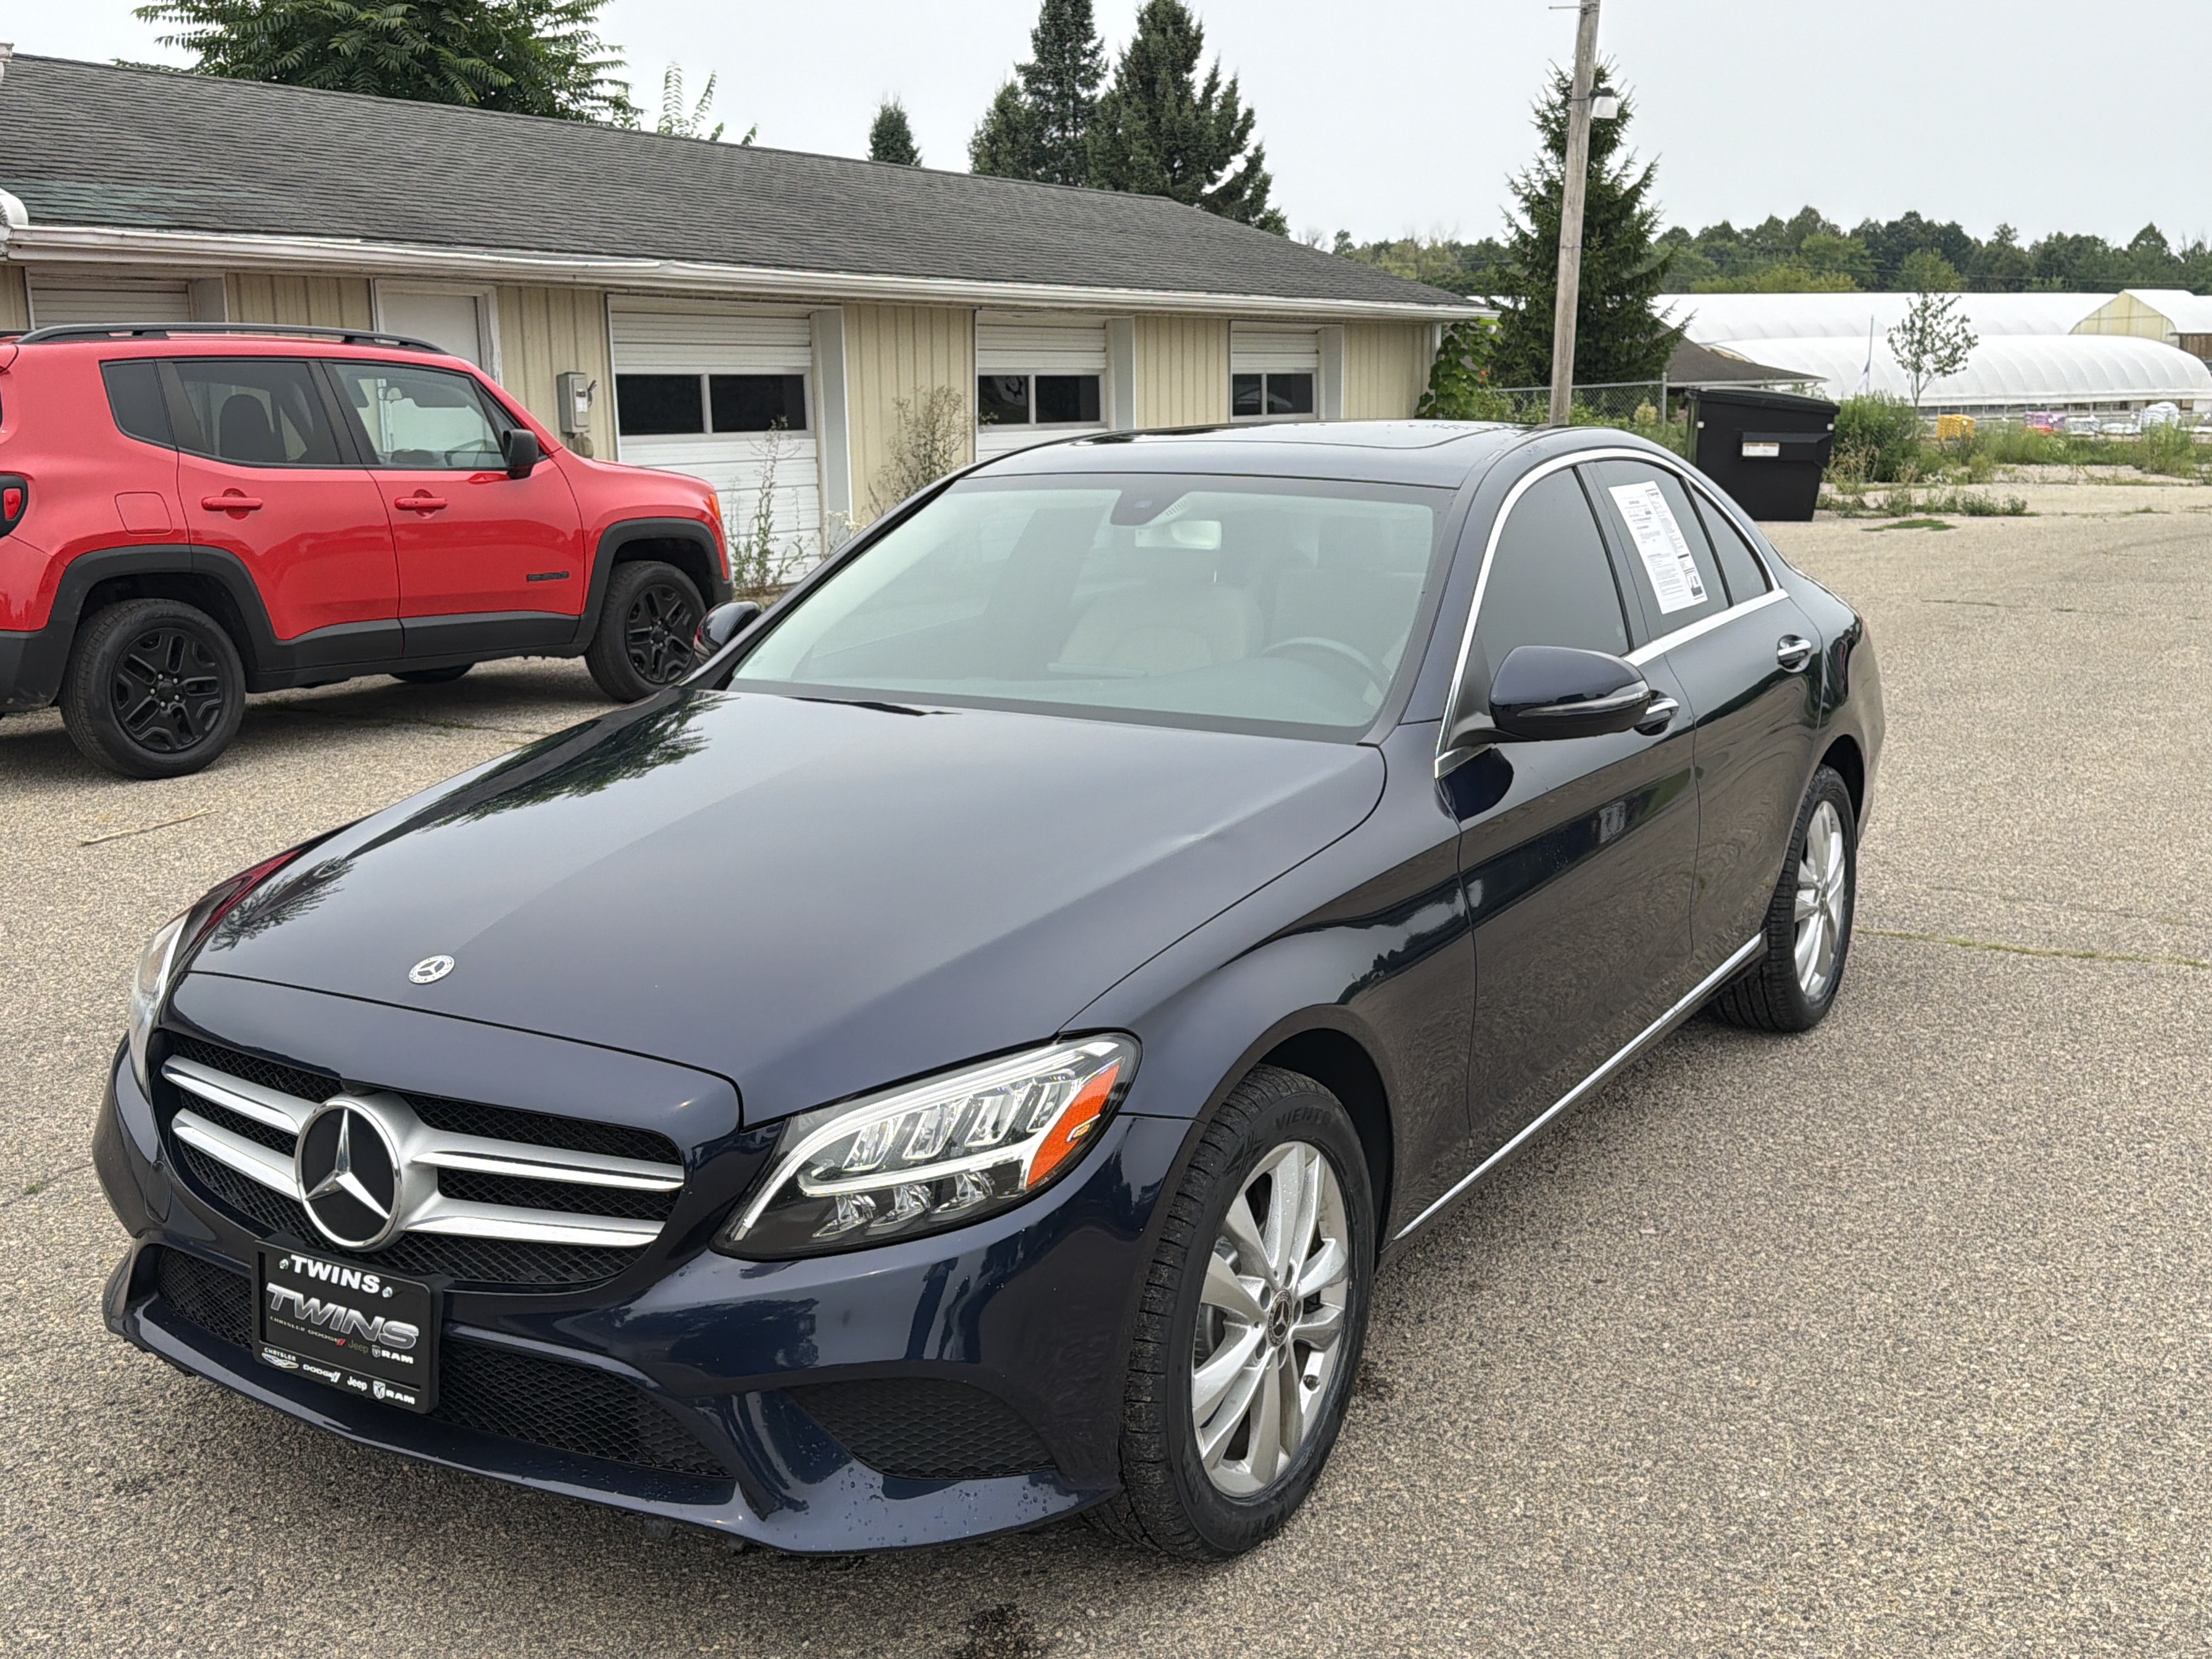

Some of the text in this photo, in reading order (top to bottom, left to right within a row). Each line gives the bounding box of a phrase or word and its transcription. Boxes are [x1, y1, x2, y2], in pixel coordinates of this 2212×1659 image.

[291, 1254, 380, 1294] TWINS
[266, 1282, 419, 1349] TWINS
[264, 1347, 297, 1361] CHRYSLER
[347, 1376, 368, 1391] Jeep
[386, 1389, 415, 1404] RAM
[348, 1339, 369, 1355] Jeep
[381, 1350, 414, 1364] RAM
